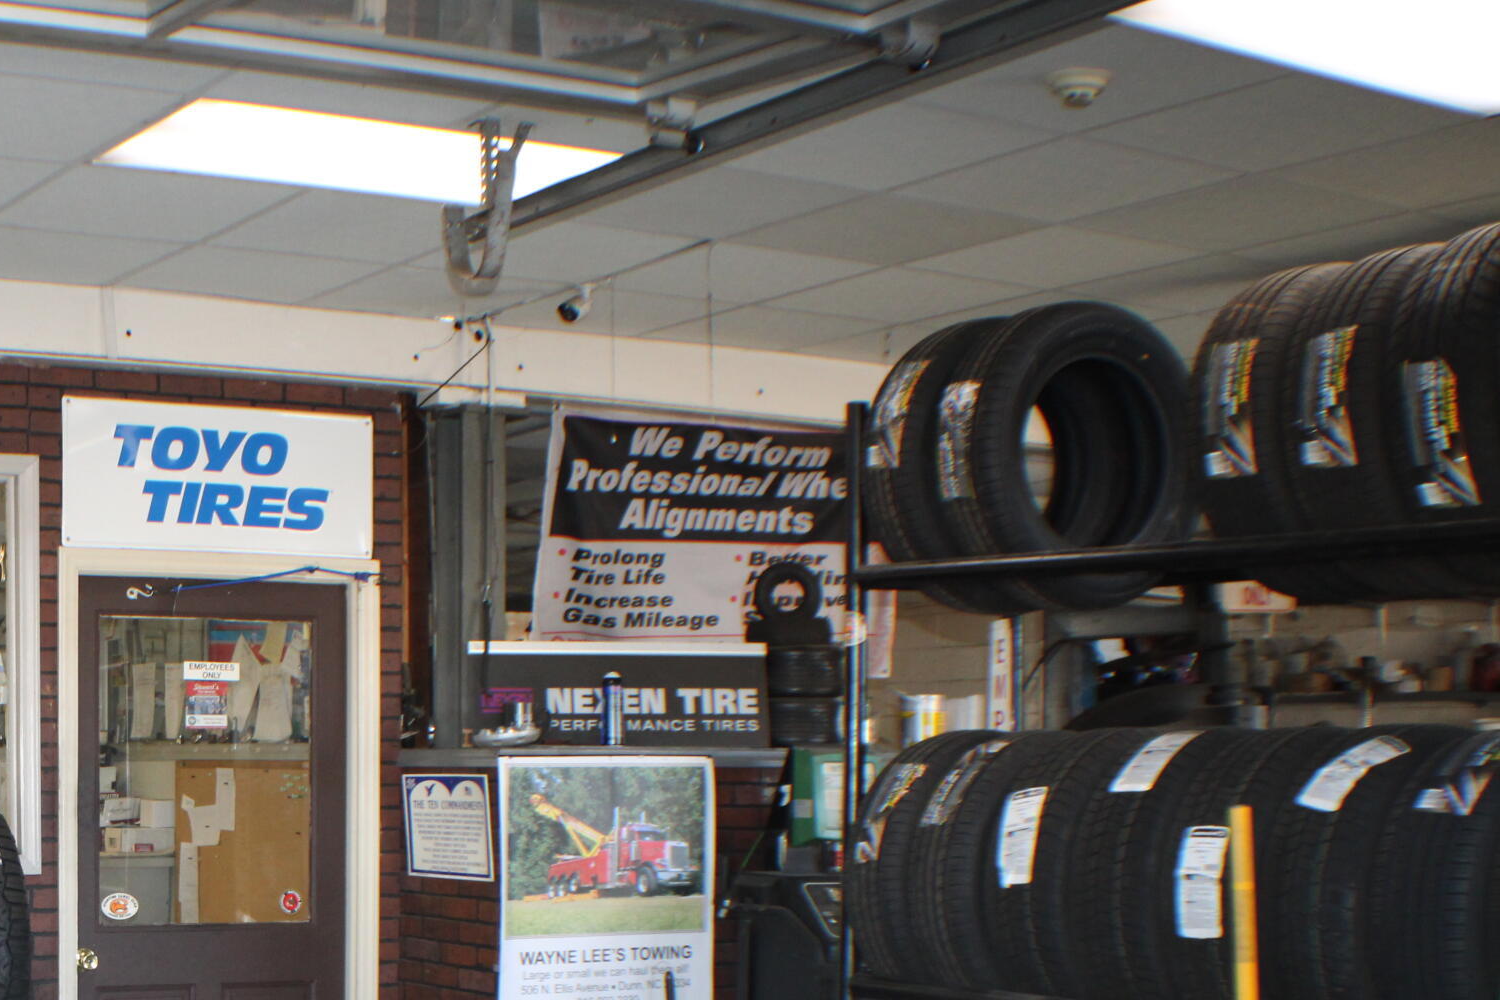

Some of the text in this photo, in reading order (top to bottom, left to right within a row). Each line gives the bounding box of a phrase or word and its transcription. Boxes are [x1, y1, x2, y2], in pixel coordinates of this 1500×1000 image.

[114, 424, 289, 476] TOYO
[629, 427, 833, 468] We Perform
[566, 458, 848, 500] Professional Whe
[142, 480, 330, 531] TIRES
[618, 497, 815, 538] Alignments
[572, 548, 828, 568] Prolong Better
[570, 567, 666, 585] Tire Life
[564, 588, 675, 609] Increase
[563, 607, 720, 630] Gas Mileage
[188, 662, 235, 671] EMPLOYEES
[202, 671, 222, 679] ONLY
[676, 688, 759, 715] TIRE
[550, 719, 759, 731] PERFMANCE TIRES
[519, 945, 692, 965] WAYNE LEE'S TOWING
[523, 971, 550, 982] Large
[554, 971, 562, 979] or
[566, 968, 591, 978] small
[609, 969, 625, 977] can
[629, 967, 648, 976] haul
[575, 983, 609, 993] Avenue
[647, 981, 661, 989] NC
